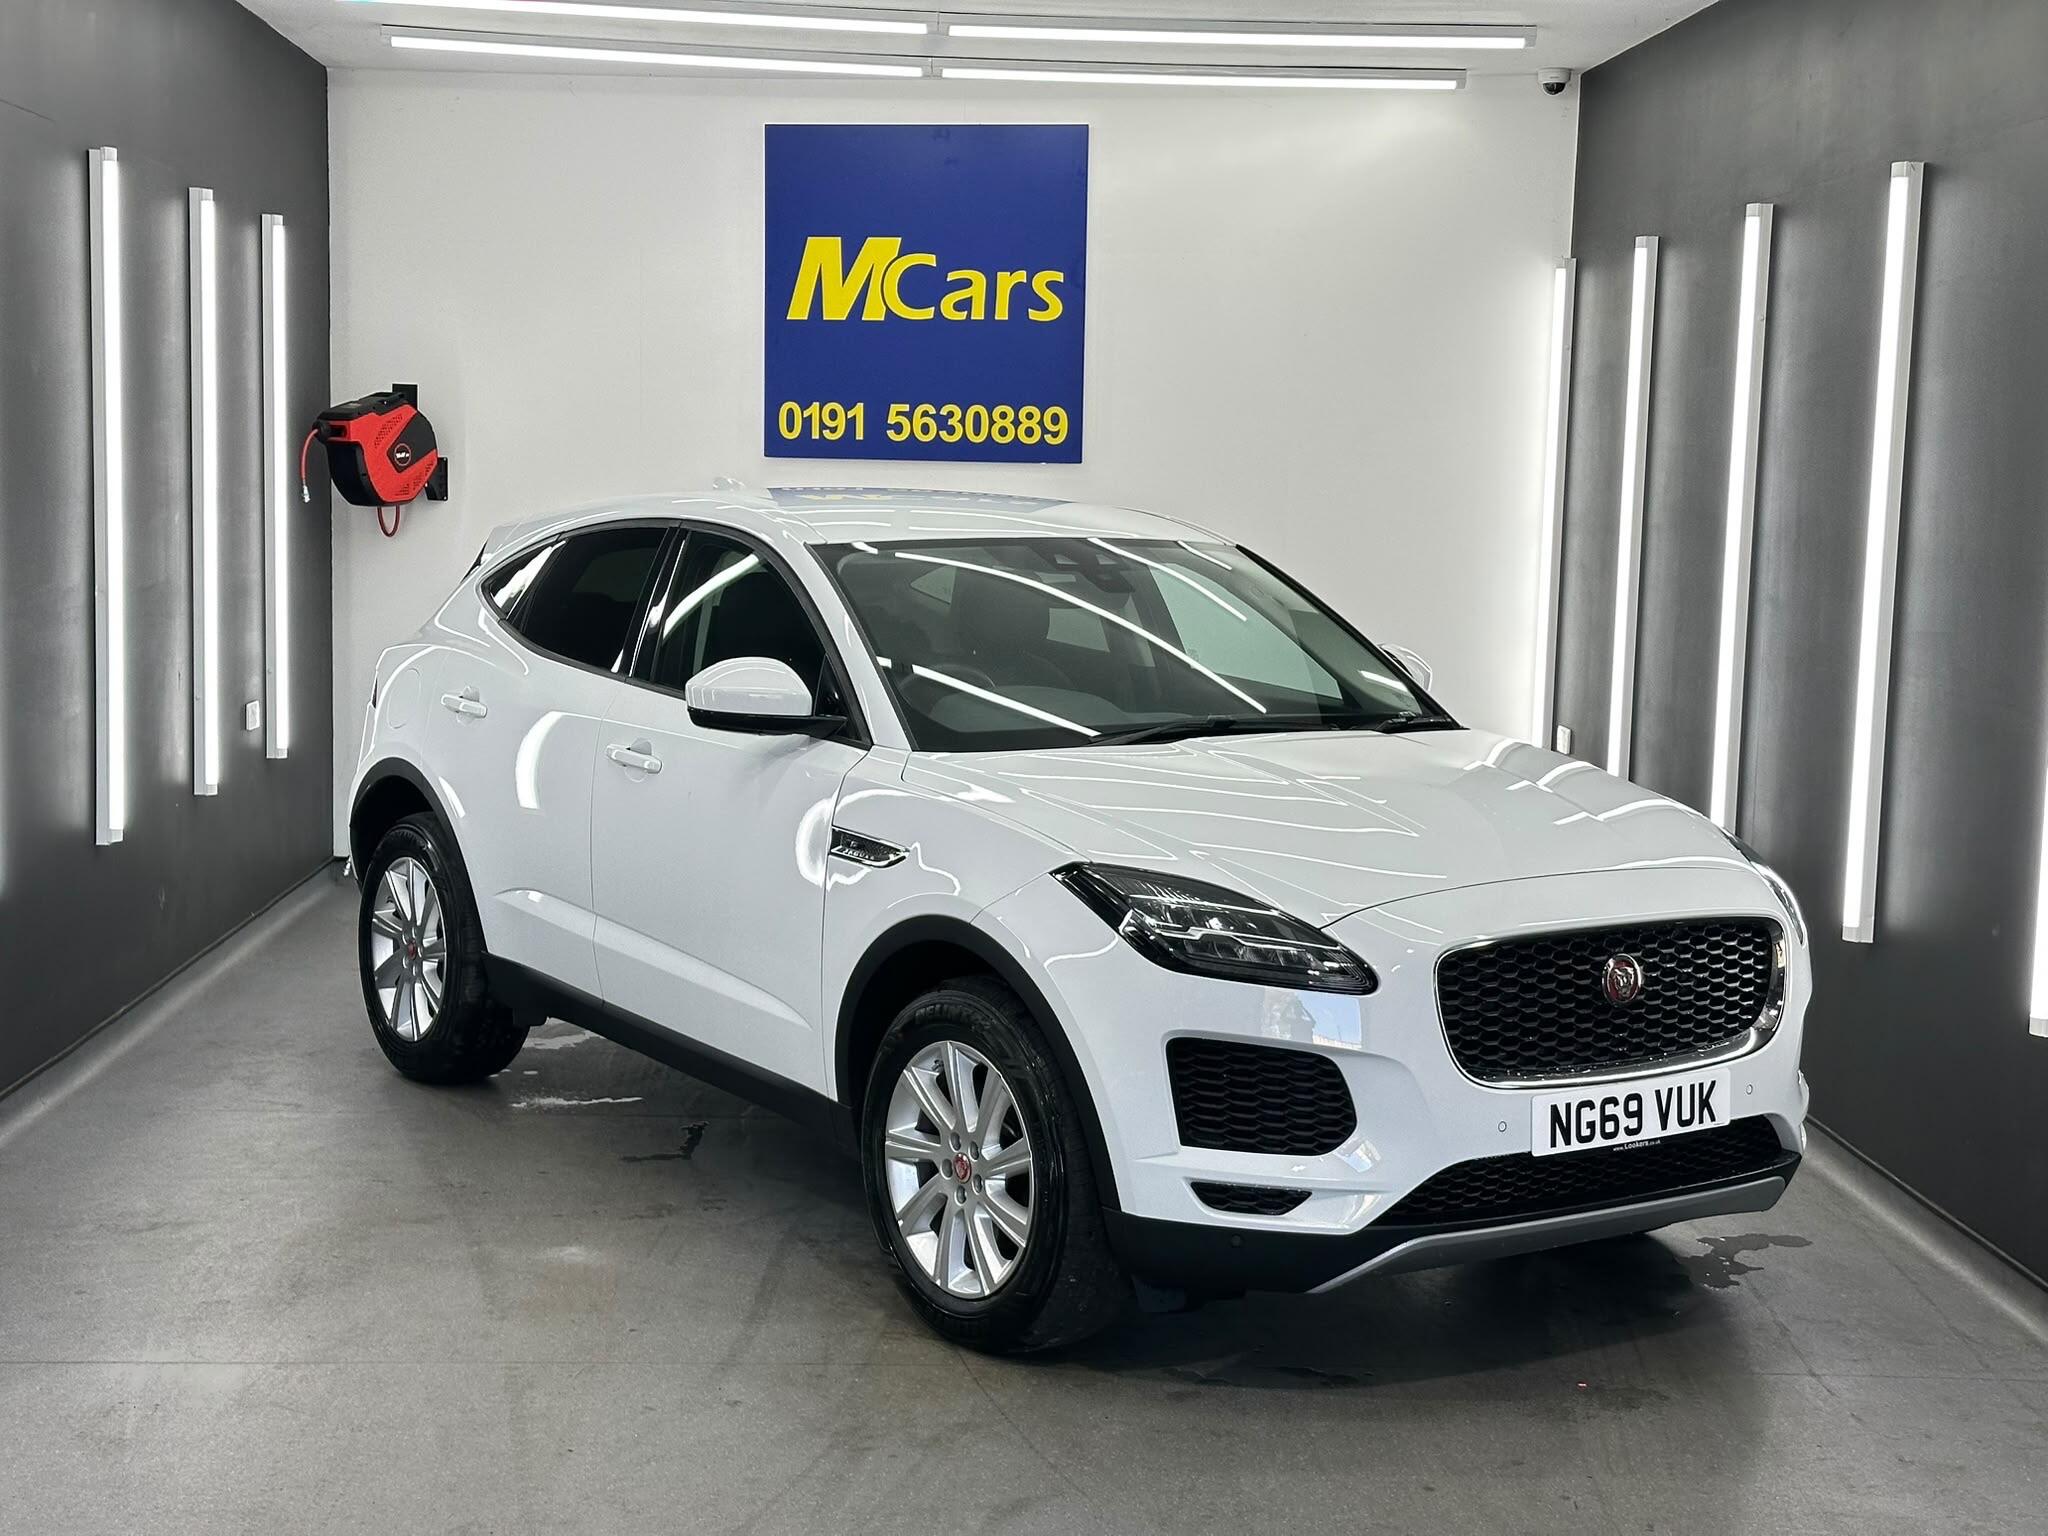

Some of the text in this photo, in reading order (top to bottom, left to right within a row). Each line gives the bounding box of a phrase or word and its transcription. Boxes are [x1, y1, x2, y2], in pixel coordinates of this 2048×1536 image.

[778, 401, 1069, 445] 0191 5630889
[1550, 1079, 1717, 1149] NG69 VUK
